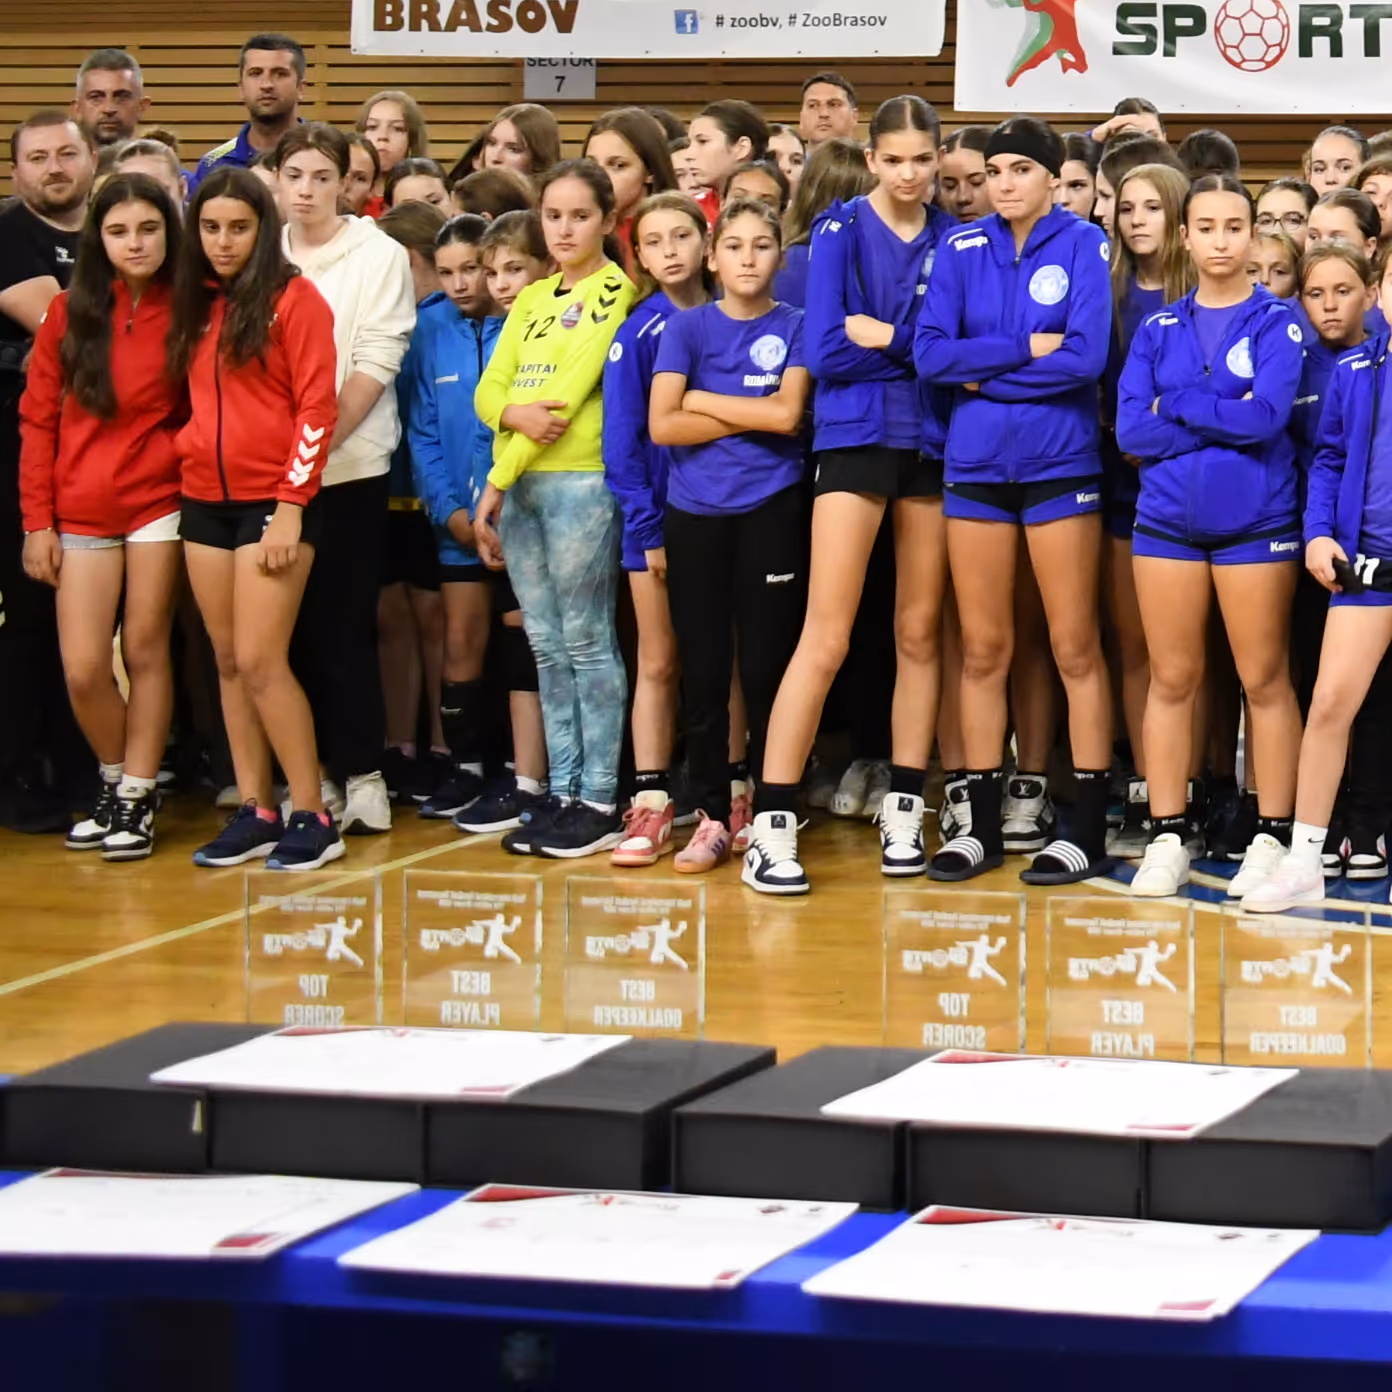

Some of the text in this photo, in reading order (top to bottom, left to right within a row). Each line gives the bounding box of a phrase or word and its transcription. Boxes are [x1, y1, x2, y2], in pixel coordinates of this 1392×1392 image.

[715, 12, 888, 30] # zoobv, # ZooBrasov
[526, 57, 595, 68] SECTOR
[554, 75, 567, 93] 7
[522, 314, 557, 342] 12
